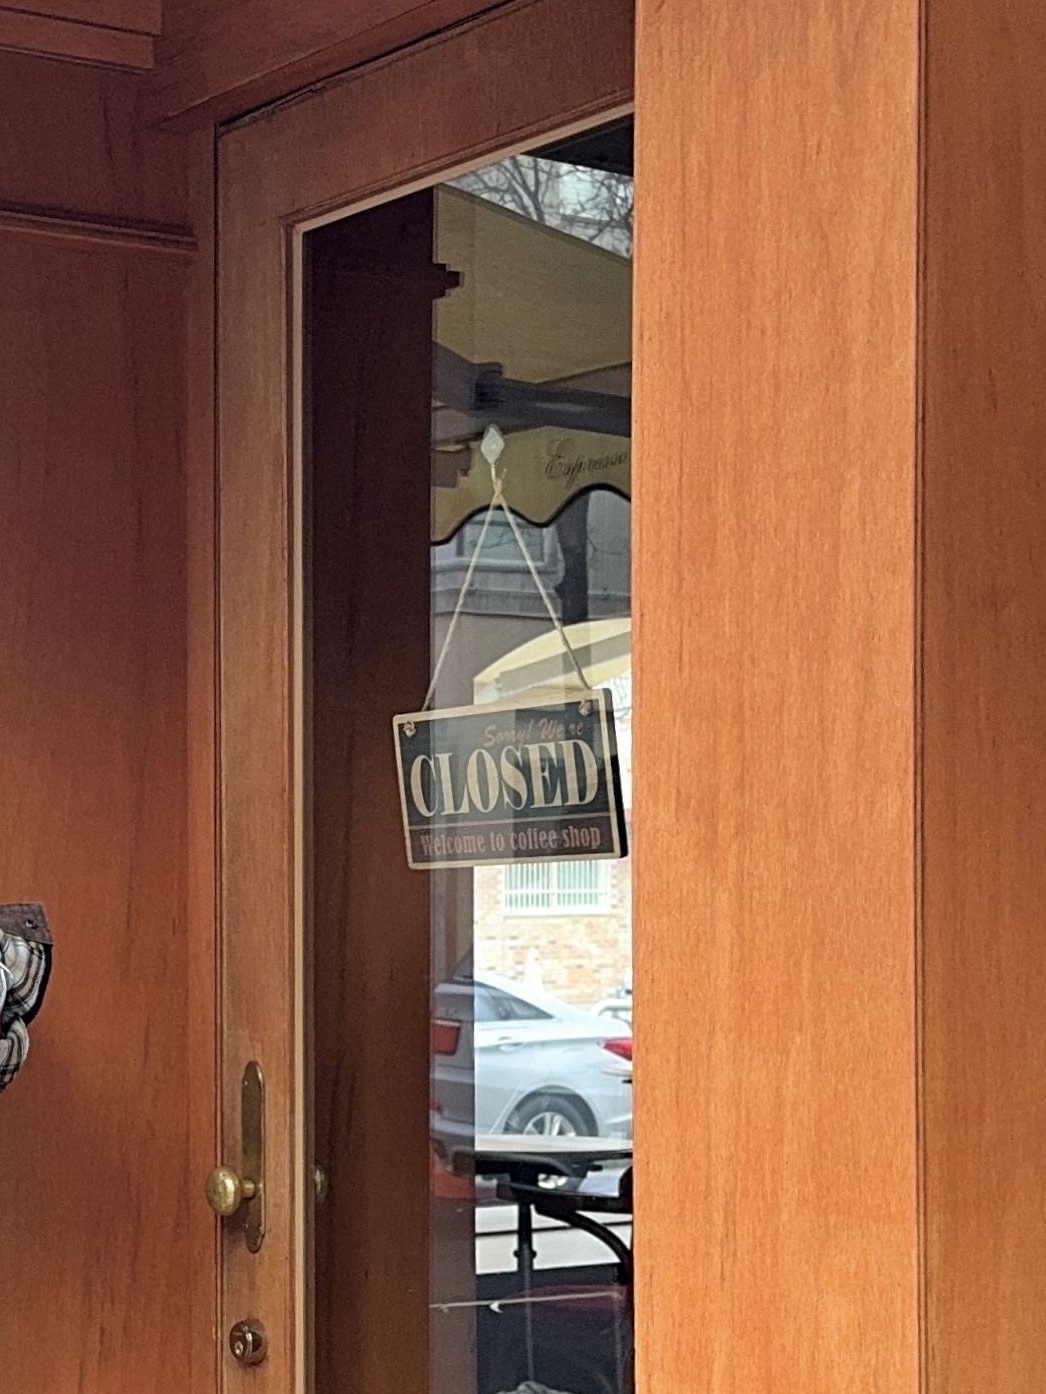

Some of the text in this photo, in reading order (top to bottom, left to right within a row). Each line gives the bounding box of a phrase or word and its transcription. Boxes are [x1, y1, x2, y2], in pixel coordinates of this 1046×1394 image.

[410, 739, 598, 817] CLOSED
[420, 825, 601, 856] Welcome to coffee shop
